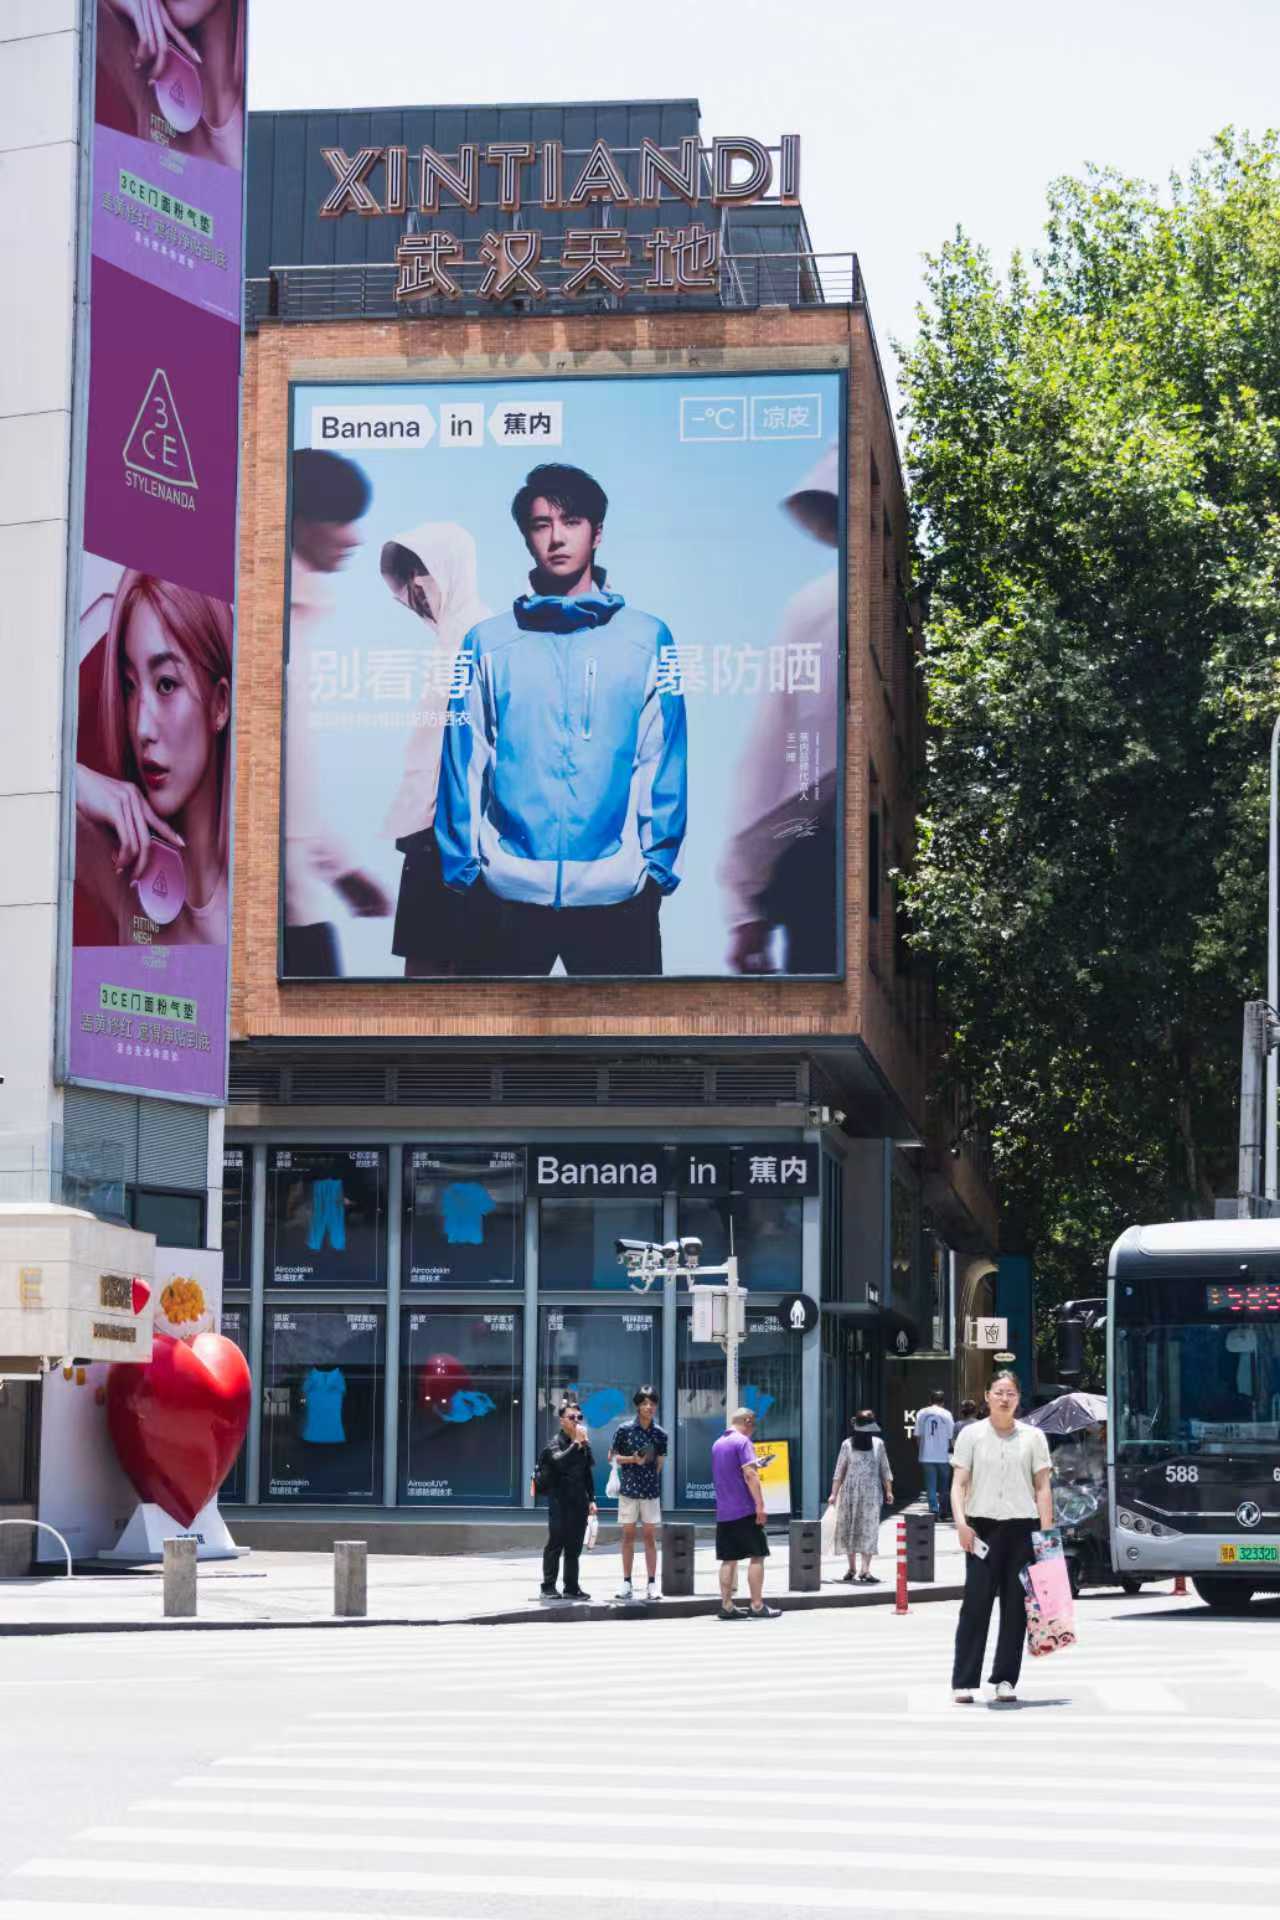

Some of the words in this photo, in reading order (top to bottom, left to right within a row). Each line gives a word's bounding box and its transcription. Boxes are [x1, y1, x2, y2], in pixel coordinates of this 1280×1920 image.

[320, 134, 800, 216] XINTIANDI
[393, 222, 720, 301] 武汉天地
[321, 415, 421, 440] Banana
[450, 414, 473, 438] in
[502, 412, 552, 437] 蕉内
[762, 406, 811, 431] 凉皮
[125, 470, 197, 512] STYLENANDA
[102, 989, 194, 1021] 3CE门面粉气垫
[537, 1156, 658, 1185] Banana
[689, 1156, 717, 1185] in
[749, 1156, 808, 1185] 蕉内
[1165, 1465, 1199, 1483] 588
